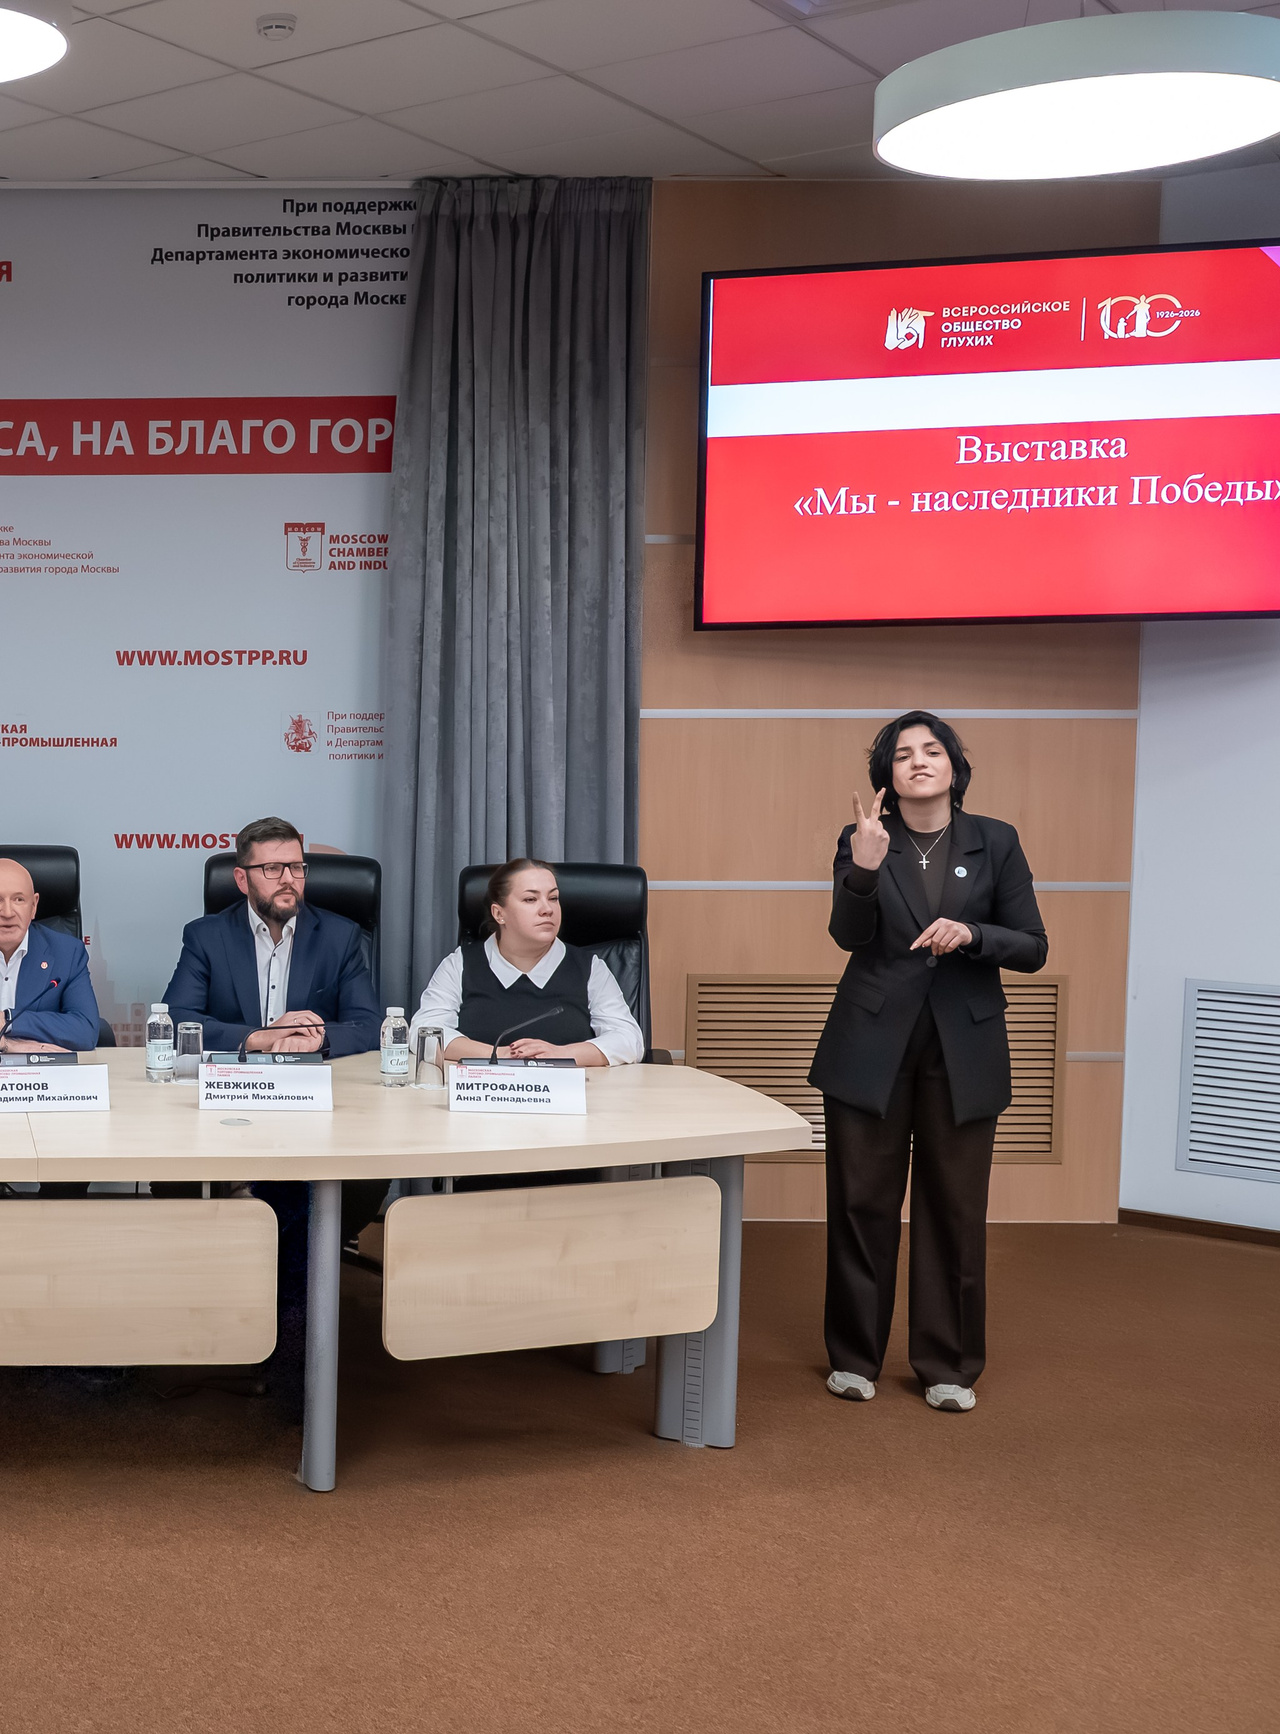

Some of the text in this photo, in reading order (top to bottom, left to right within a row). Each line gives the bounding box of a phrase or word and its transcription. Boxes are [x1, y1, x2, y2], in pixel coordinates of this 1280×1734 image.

[282, 199, 317, 216] При
[197, 224, 331, 241] Правительства
[335, 221, 407, 236] Москвы
[150, 247, 410, 265] Департамента экономическо
[233, 271, 318, 284] политики
[322, 272, 334, 283] и
[287, 295, 349, 310] города
[942, 300, 1070, 318] ВСЕРОССИЙСКОЕ
[941, 318, 1022, 333] ОБЩЕСТВО
[940, 334, 994, 348] ГЛУХИХ
[72, 421, 135, 455] НА
[148, 418, 296, 455] БЛАГО
[309, 417, 393, 454] ГОР
[955, 435, 1128, 464] Выставка
[793, 487, 876, 516] «Мы
[911, 484, 1118, 514] наследники
[12, 537, 51, 547] Москвы
[329, 534, 389, 544] MOSCOW
[17, 551, 94, 560] экономической
[44, 566, 78, 575] города
[81, 564, 120, 574] Москвы
[328, 560, 356, 570] AND
[115, 650, 308, 666] WWW.MOSTPP.RU
[327, 711, 347, 722] При
[205, 1081, 275, 1090] ЖЕВЖИКОВ
[456, 1082, 550, 1093] МИТРОФАНОВА
[37, 1094, 98, 1102] Михайлович
[205, 1093, 314, 1101] Дмитрий Михайлович
[456, 1094, 551, 1104] Анна Геннадьевна
